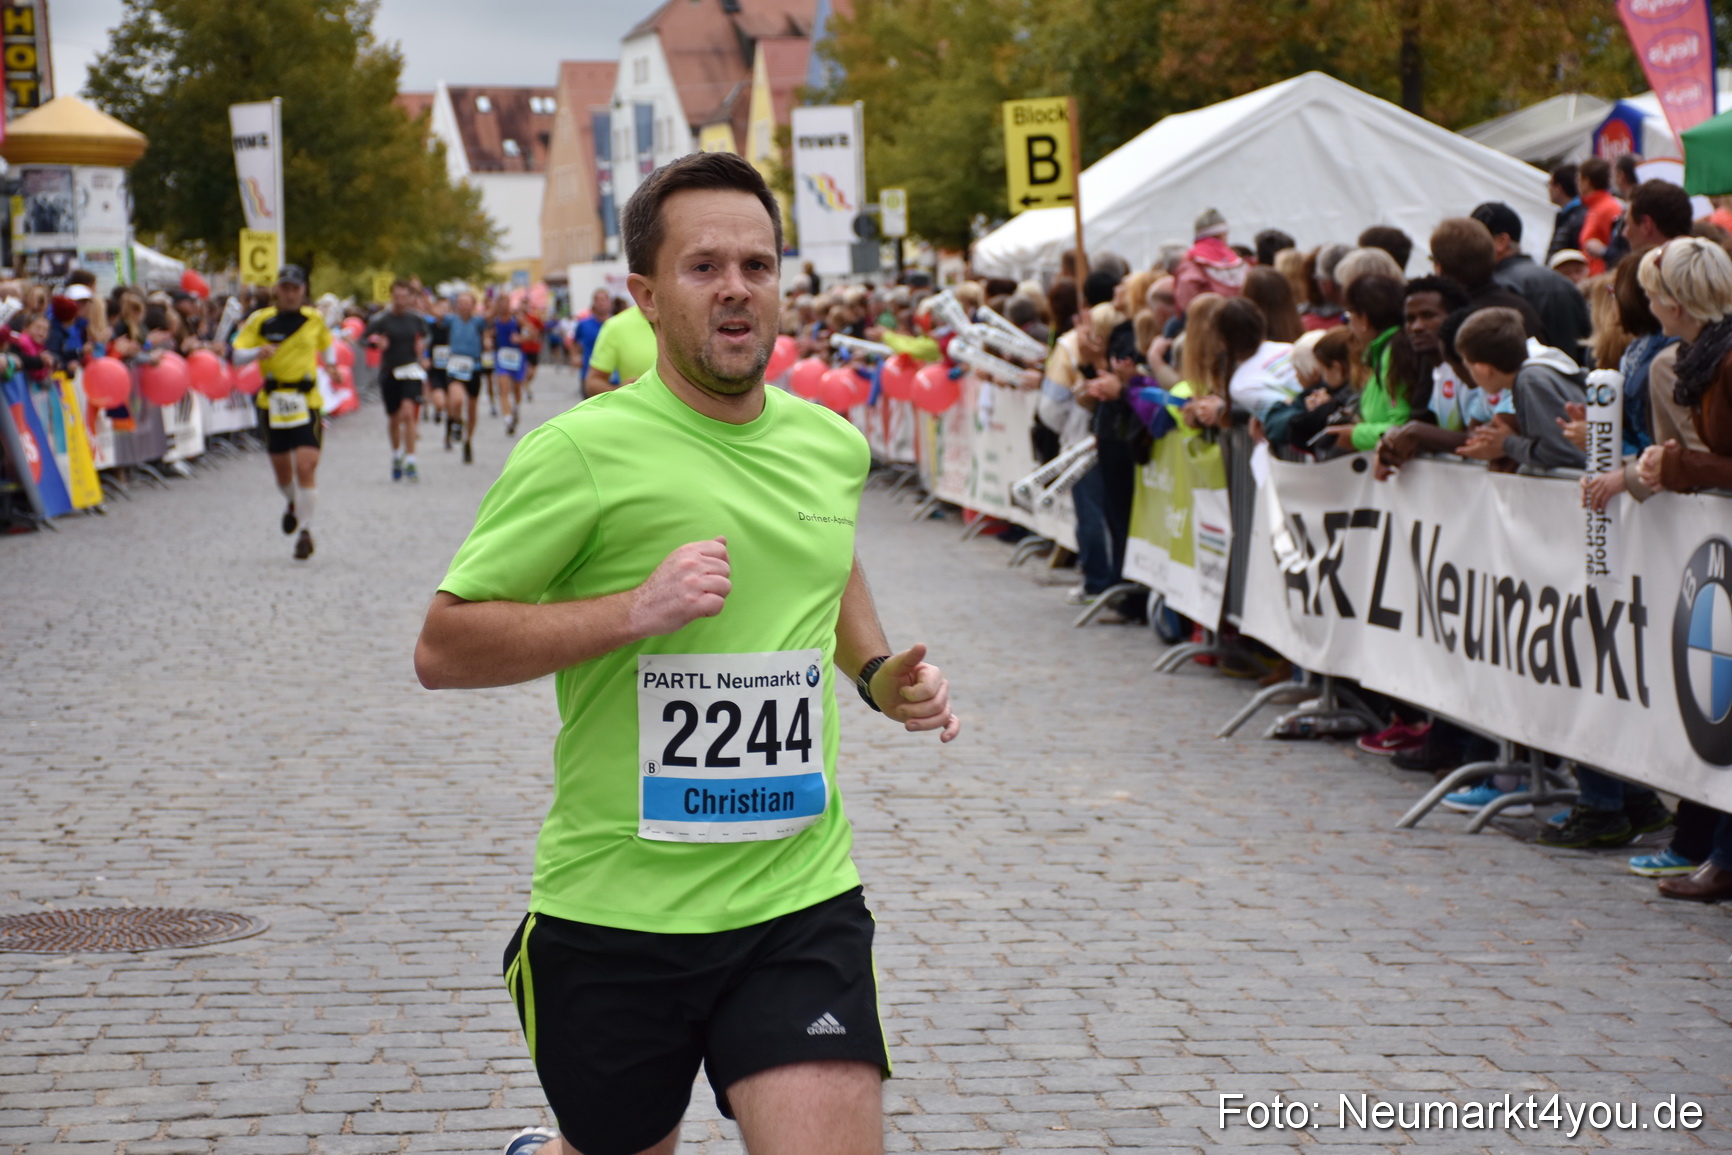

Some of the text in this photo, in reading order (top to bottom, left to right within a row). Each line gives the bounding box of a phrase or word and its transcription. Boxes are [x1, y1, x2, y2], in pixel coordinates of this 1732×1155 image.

[1013, 104, 1069, 126] Block
[1027, 135, 1061, 185] B
[249, 246, 267, 273] C
[1596, 422, 1612, 474] BMW
[1411, 520, 1649, 708] Neumarkt
[643, 670, 801, 690] PARTL Neumarkt
[662, 697, 812, 768] 2244
[648, 762, 656, 774] B
[684, 787, 795, 815] Christian
[806, 1024, 847, 1036] adidas
